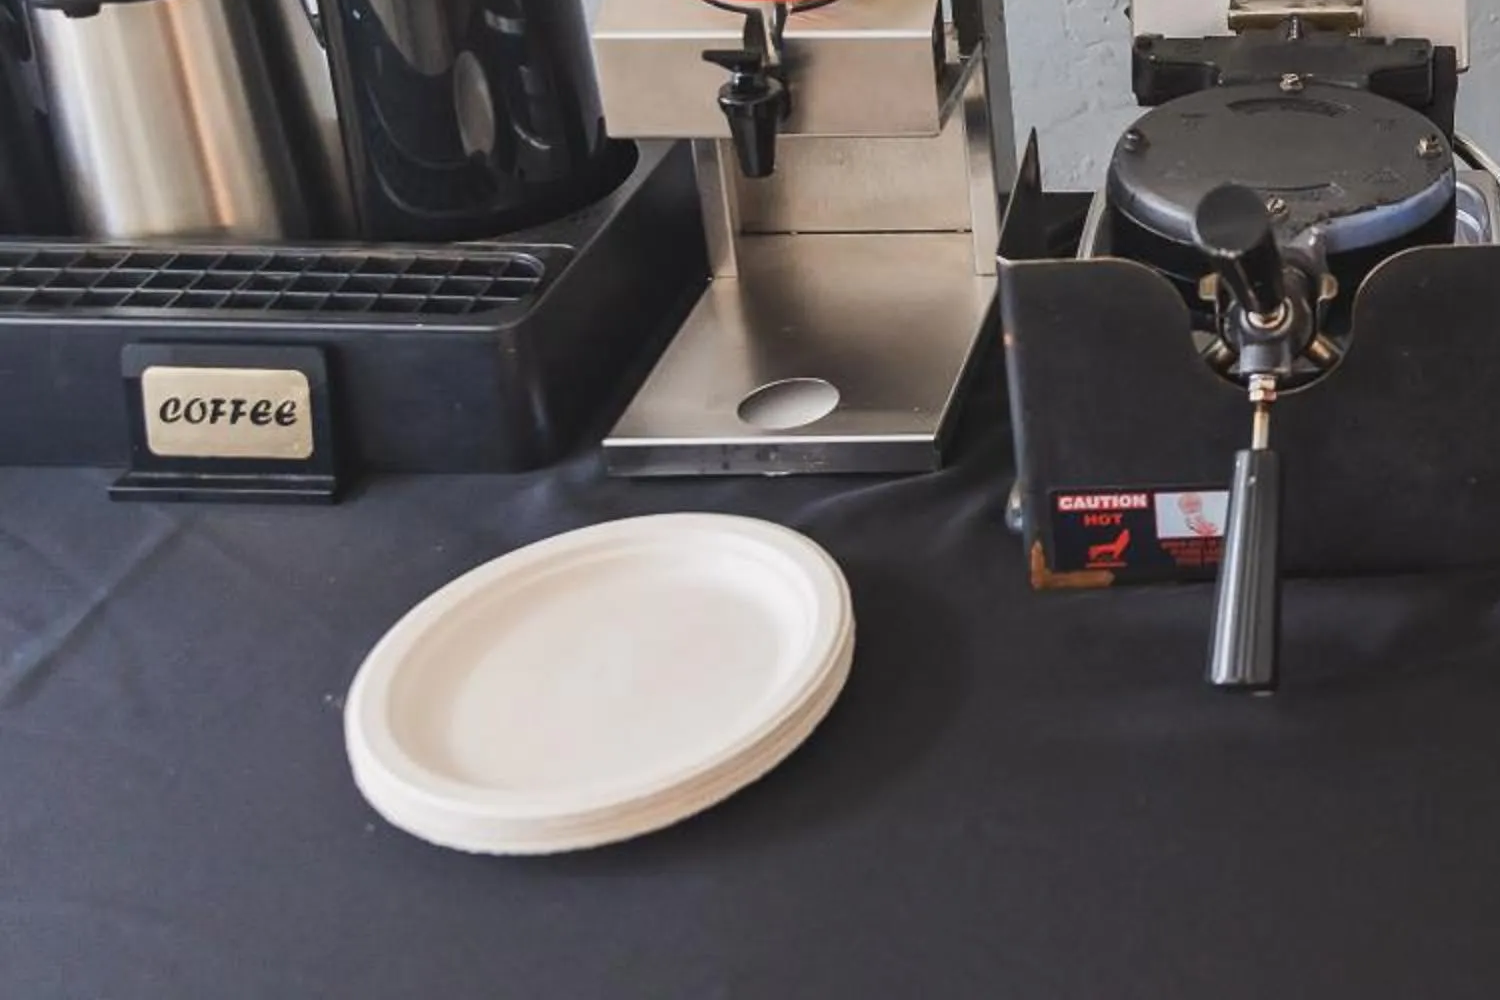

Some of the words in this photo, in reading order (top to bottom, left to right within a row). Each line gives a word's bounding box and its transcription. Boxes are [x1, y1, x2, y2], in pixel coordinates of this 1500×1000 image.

[159, 397, 298, 427] COFFEE
[1057, 493, 1149, 511] CAUTION
[1084, 513, 1123, 526] HOT
